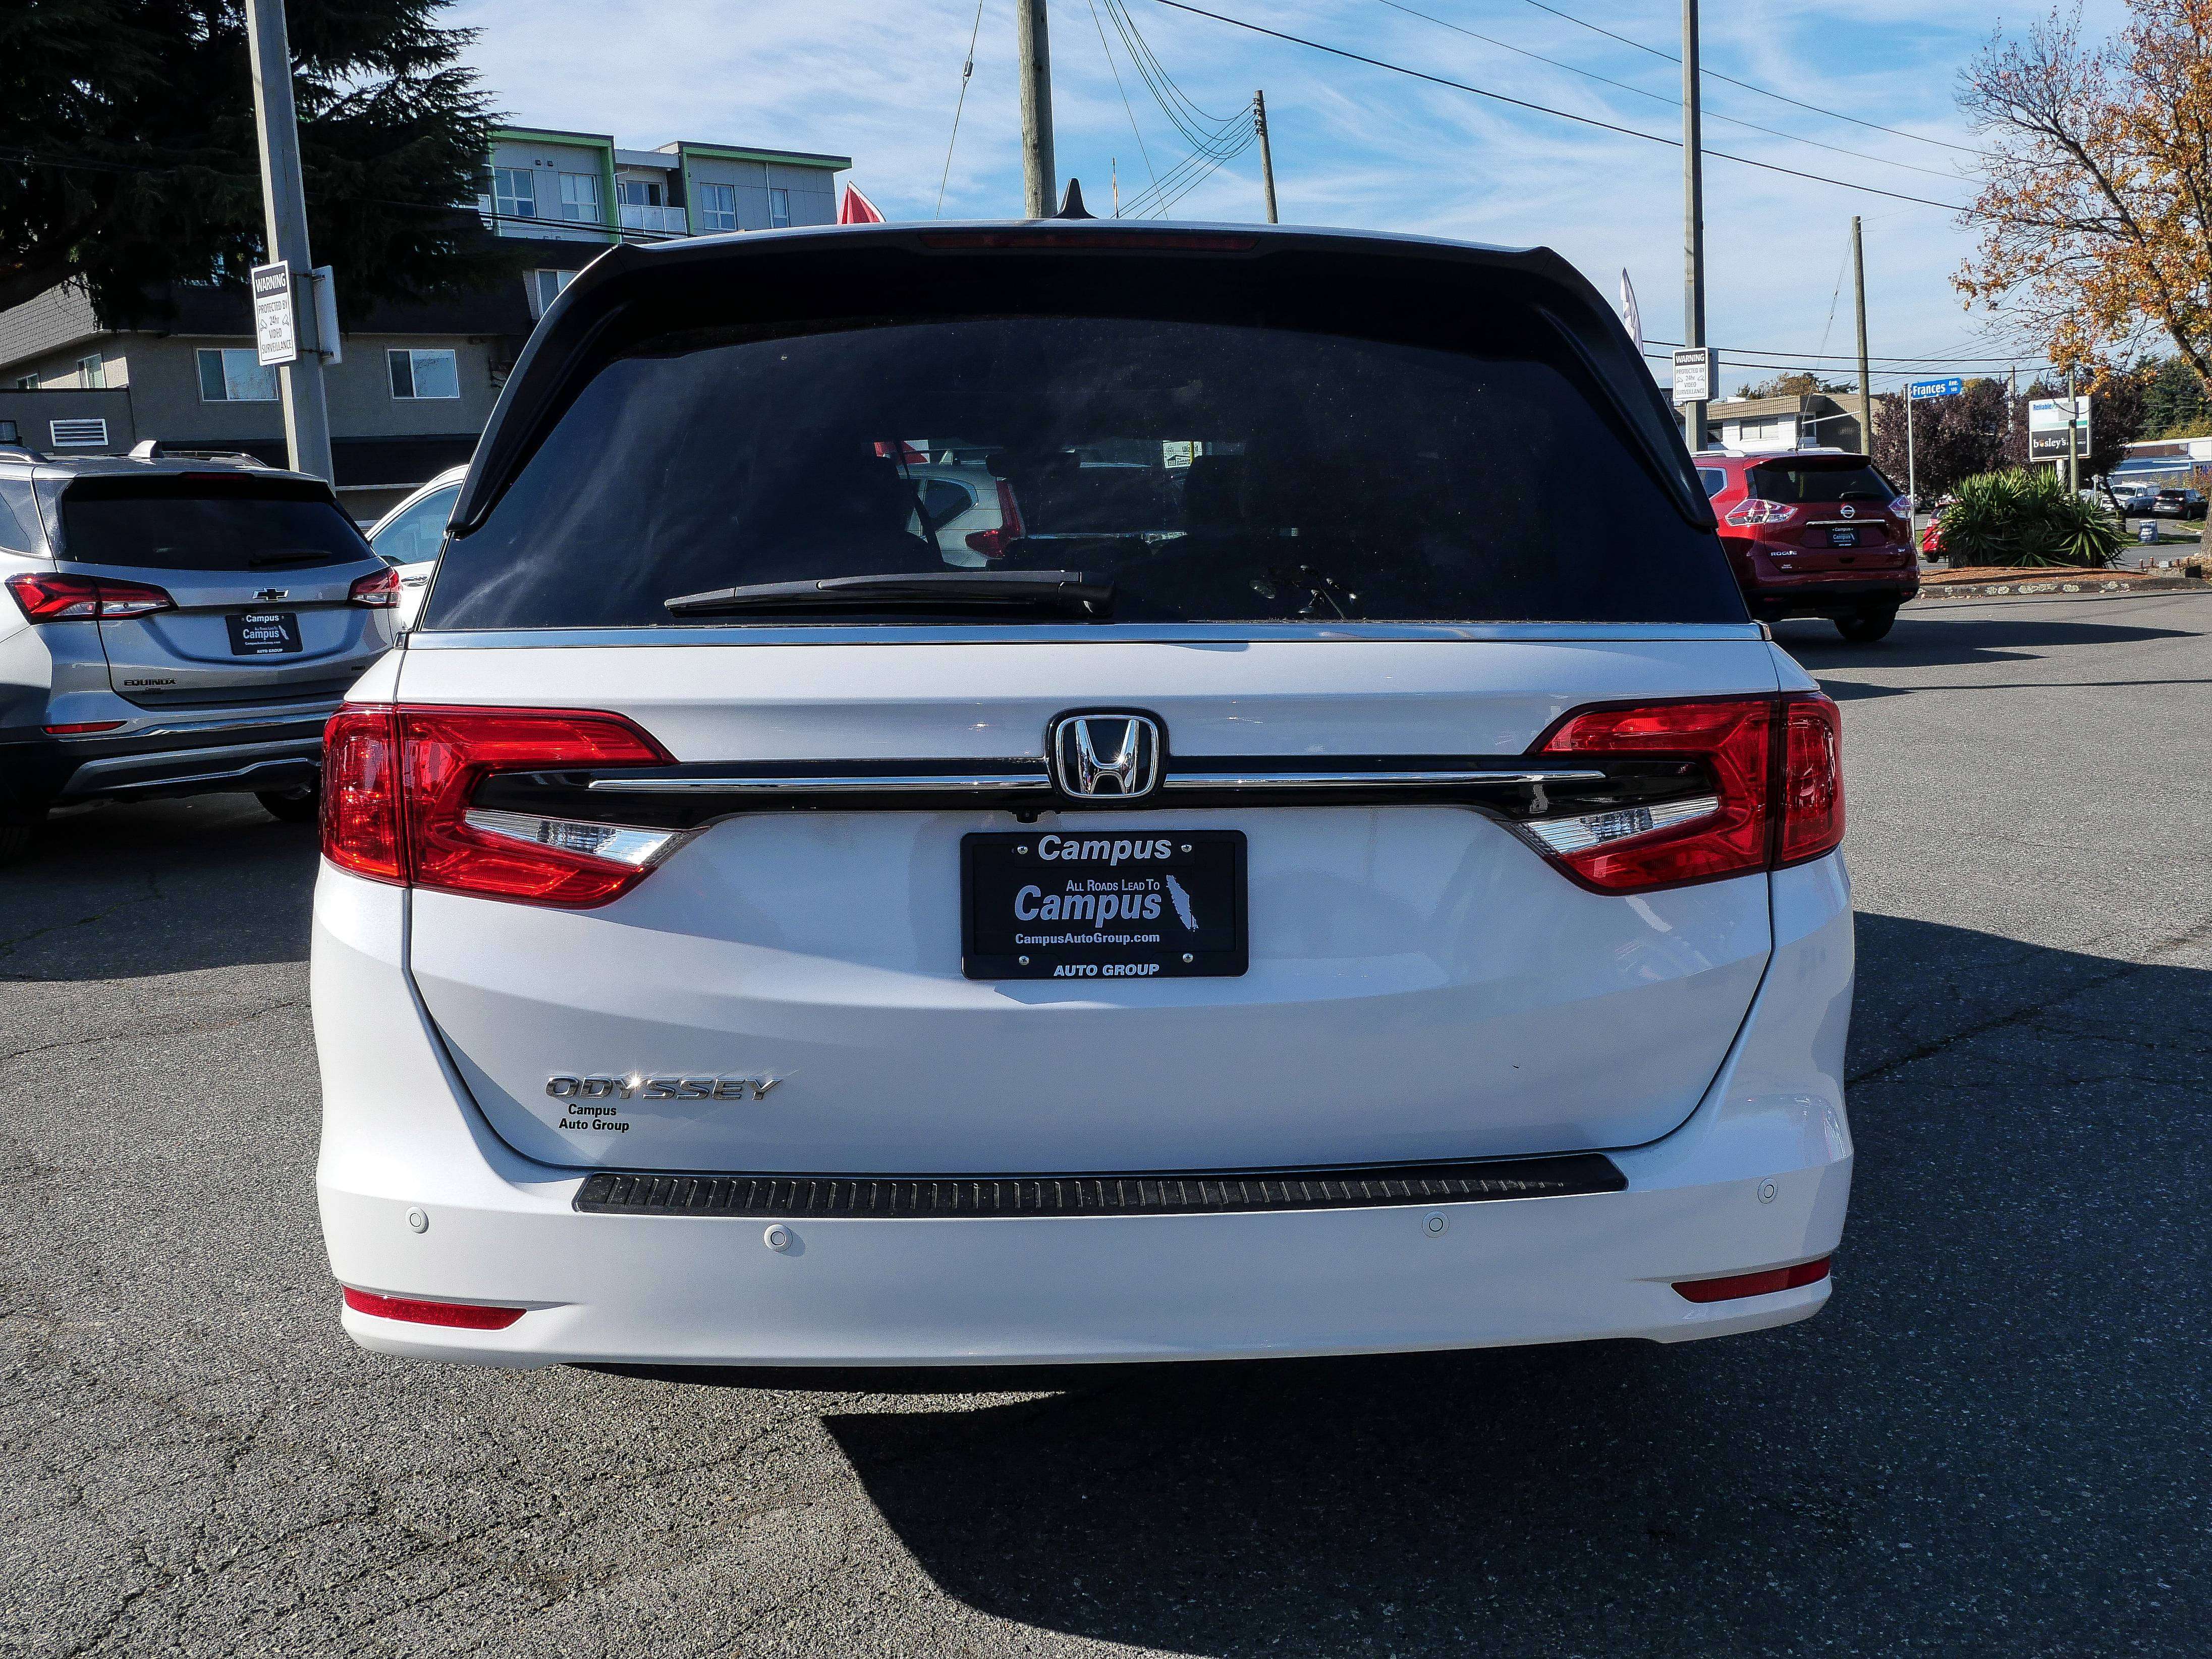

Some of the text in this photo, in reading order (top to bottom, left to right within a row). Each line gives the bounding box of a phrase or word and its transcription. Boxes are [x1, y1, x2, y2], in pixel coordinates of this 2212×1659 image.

[255, 272, 286, 293] WARNING
[258, 299, 288, 314] PROTECTED BY
[269, 316, 280, 326] 24hr
[268, 328, 282, 339] VIDEO
[261, 340, 292, 354] SURVEILLANCE
[1675, 353, 1705, 364] WARNING
[1913, 383, 1946, 396] Frances
[246, 615, 279, 623] Campus
[243, 629, 280, 640] Campus
[124, 678, 177, 686] EQUINOX
[1038, 835, 1172, 866] Campus
[1014, 884, 1162, 928] Campus
[1015, 932, 1160, 945] CampusAutoGroup.com
[1053, 964, 1160, 976] AUTO GROUP
[545, 1075, 784, 1100] ODYSSEY
[568, 1103, 617, 1117] Campus
[558, 1118, 630, 1133] Auto Group
